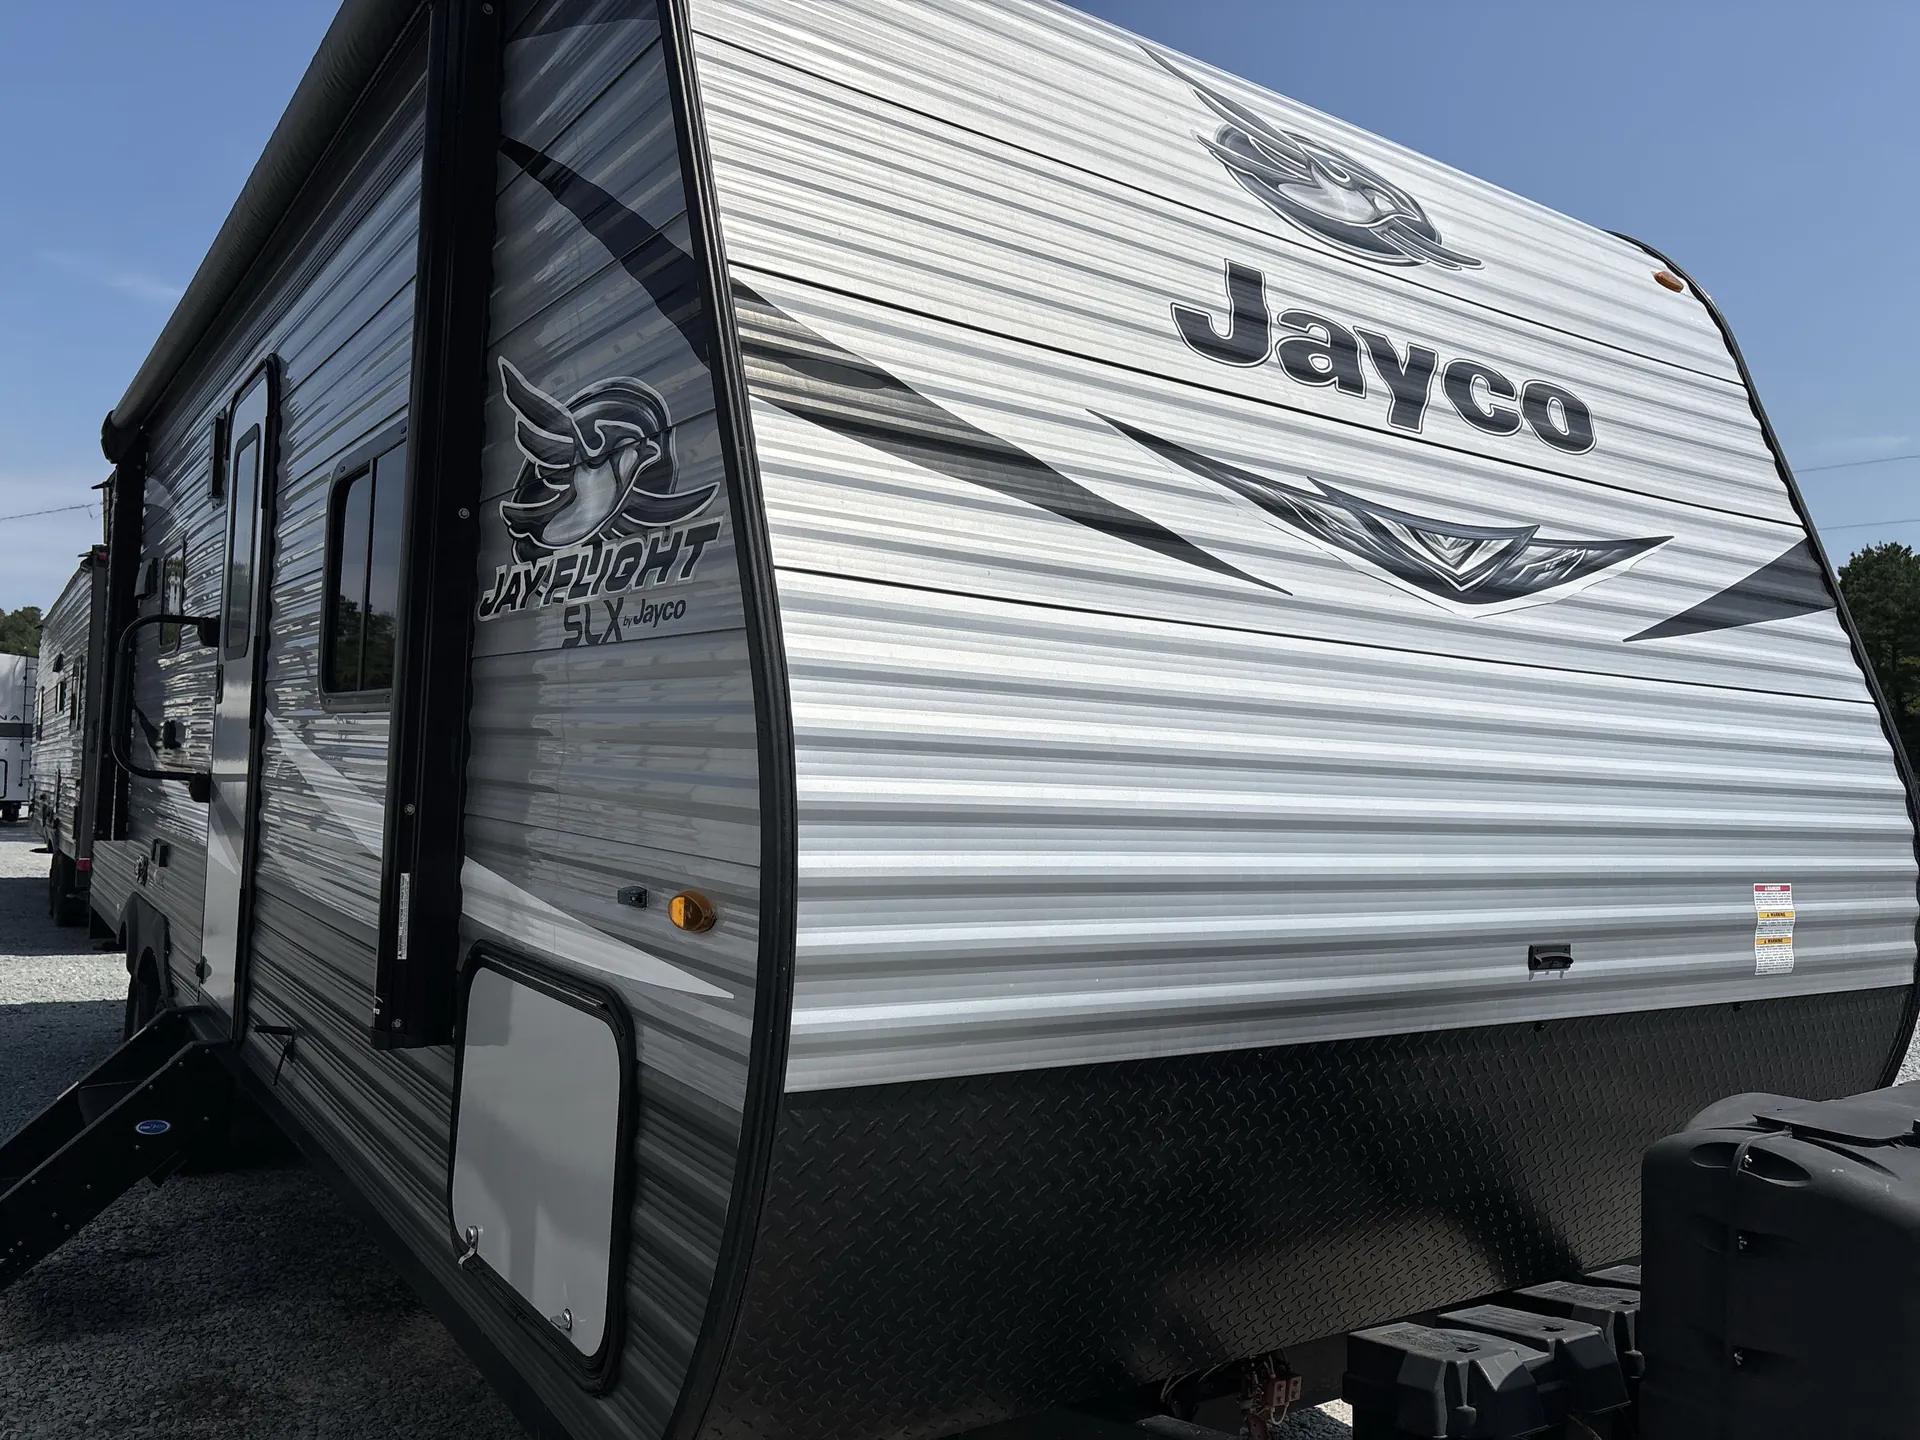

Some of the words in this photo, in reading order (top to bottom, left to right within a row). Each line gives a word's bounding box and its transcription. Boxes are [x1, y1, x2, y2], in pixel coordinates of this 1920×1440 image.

[1170, 258, 1597, 455] Jayco
[479, 563, 549, 620] JAY
[541, 519, 722, 605] FLIGHT
[562, 597, 624, 649] SLX
[623, 615, 633, 627] by
[633, 599, 687, 628] Jayco
